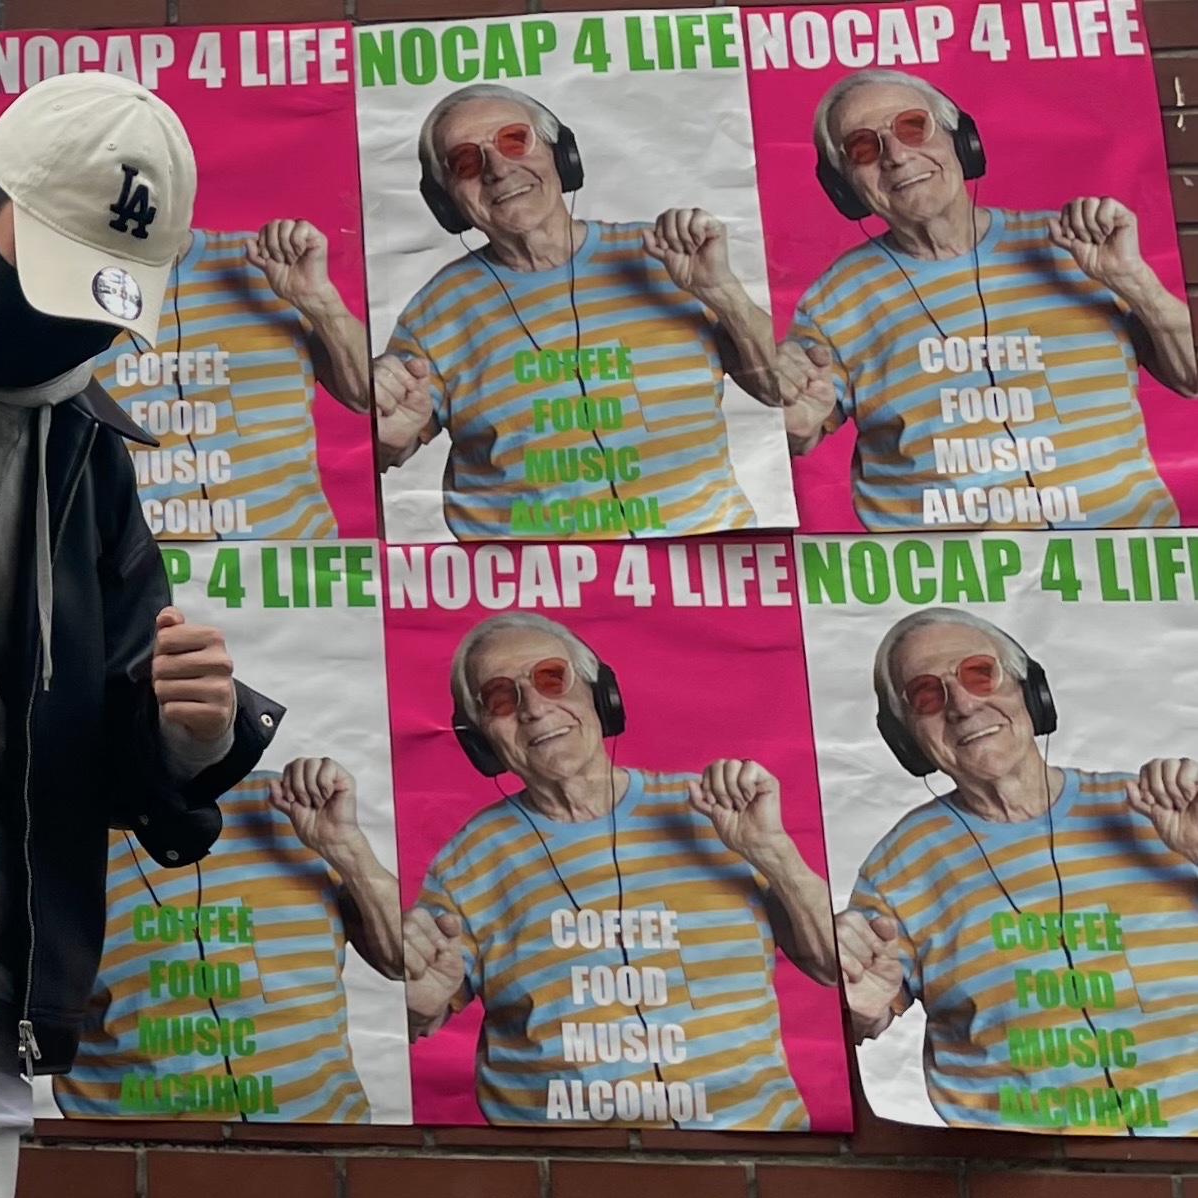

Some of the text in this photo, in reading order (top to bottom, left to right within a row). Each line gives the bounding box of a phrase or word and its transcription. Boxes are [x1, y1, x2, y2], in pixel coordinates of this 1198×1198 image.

[359, 14, 739, 88] NOCAP 4 LIFE
[750, 0, 1145, 71] NOCAP 4 LIFE
[188, 32, 226, 88] 4
[240, 28, 349, 87] LIFE
[109, 163, 157, 239] LA
[116, 352, 230, 387] COFFEE
[513, 346, 632, 384] COFFEE
[919, 335, 1044, 374] COFFEE
[131, 401, 216, 436] FOOD
[533, 397, 623, 433] FOOD
[940, 386, 1034, 424] FOOD
[524, 446, 641, 484] MUSIC
[933, 435, 1057, 474] MUSIC
[142, 499, 252, 535] COHOL
[510, 497, 668, 534] ALCOHOL
[922, 487, 1087, 525] ALCOHOL
[207, 547, 245, 608] 4
[260, 547, 376, 608] LIFE
[389, 543, 792, 610] NOCAP 4 LIFE
[801, 539, 1022, 605] NOCAP
[1041, 538, 1082, 602] 4
[132, 905, 254, 942] COFFEE
[550, 909, 680, 950] COFFEE
[990, 912, 1124, 952] COFFEE
[149, 961, 240, 1000] FOOD
[572, 966, 667, 1006] FOOD
[1014, 969, 1115, 1009] FOOD
[137, 1017, 256, 1057] MUSIC
[562, 1022, 686, 1064] MUSIC
[1008, 1028, 1137, 1069] MUSIC
[120, 1075, 281, 1115] ALCOHOL
[546, 1079, 714, 1123] ALCOHOL
[998, 1085, 1169, 1128] ALCOHOL
